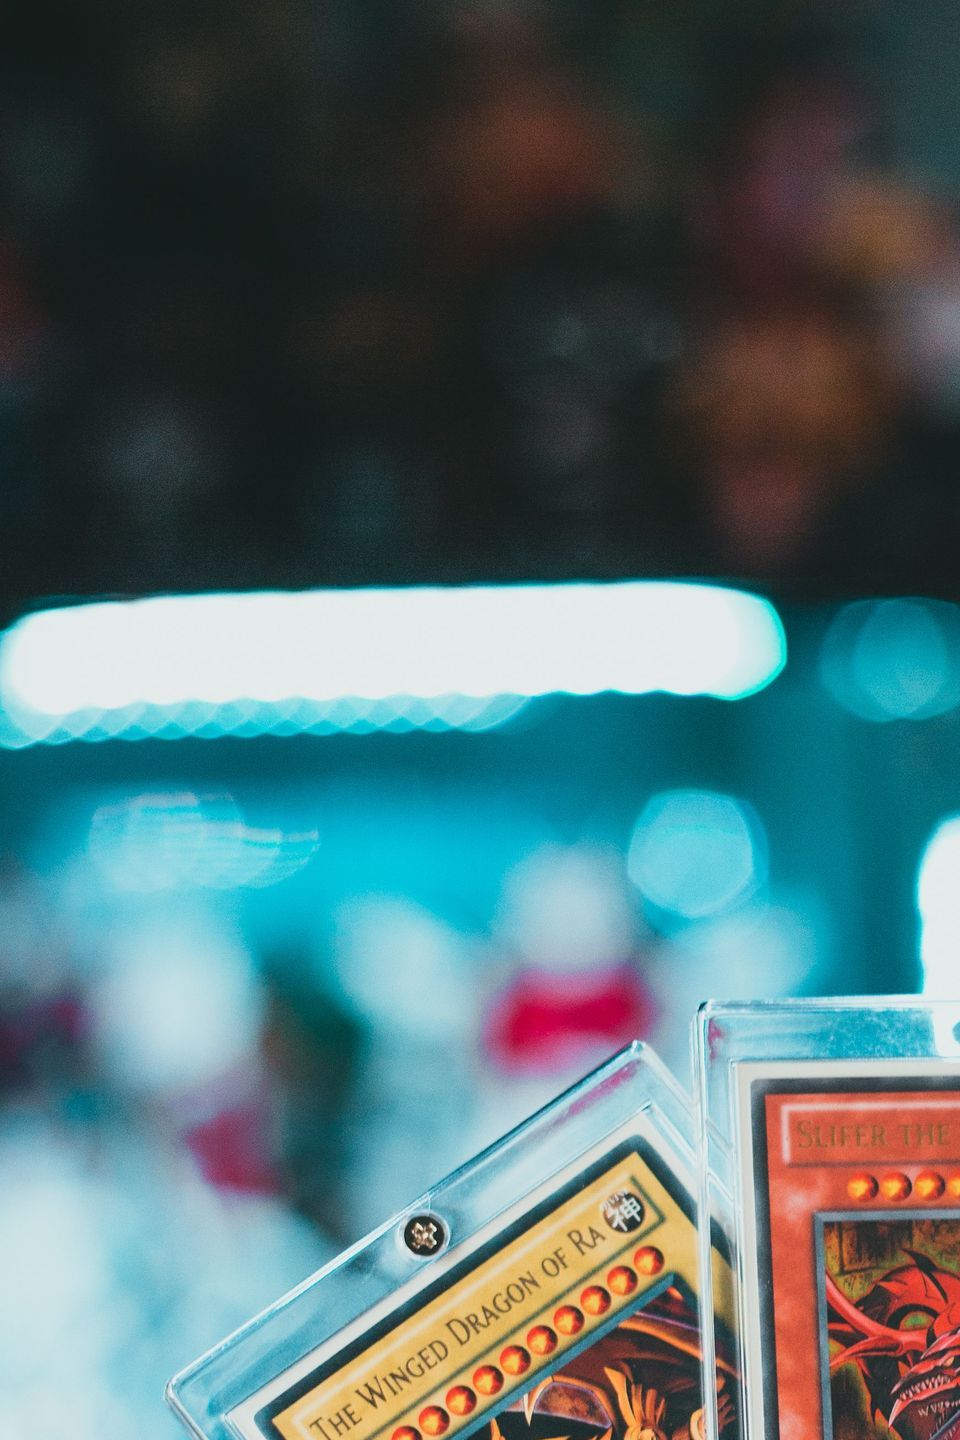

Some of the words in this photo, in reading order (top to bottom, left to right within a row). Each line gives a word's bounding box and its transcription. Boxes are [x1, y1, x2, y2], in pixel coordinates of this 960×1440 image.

[897, 1121, 950, 1147] THE
[607, 1197, 641, 1231] 神
[356, 1338, 452, 1408] WINGED
[445, 1271, 542, 1346] DRAGON
[540, 1247, 570, 1278] OF
[567, 1226, 606, 1256] RA
